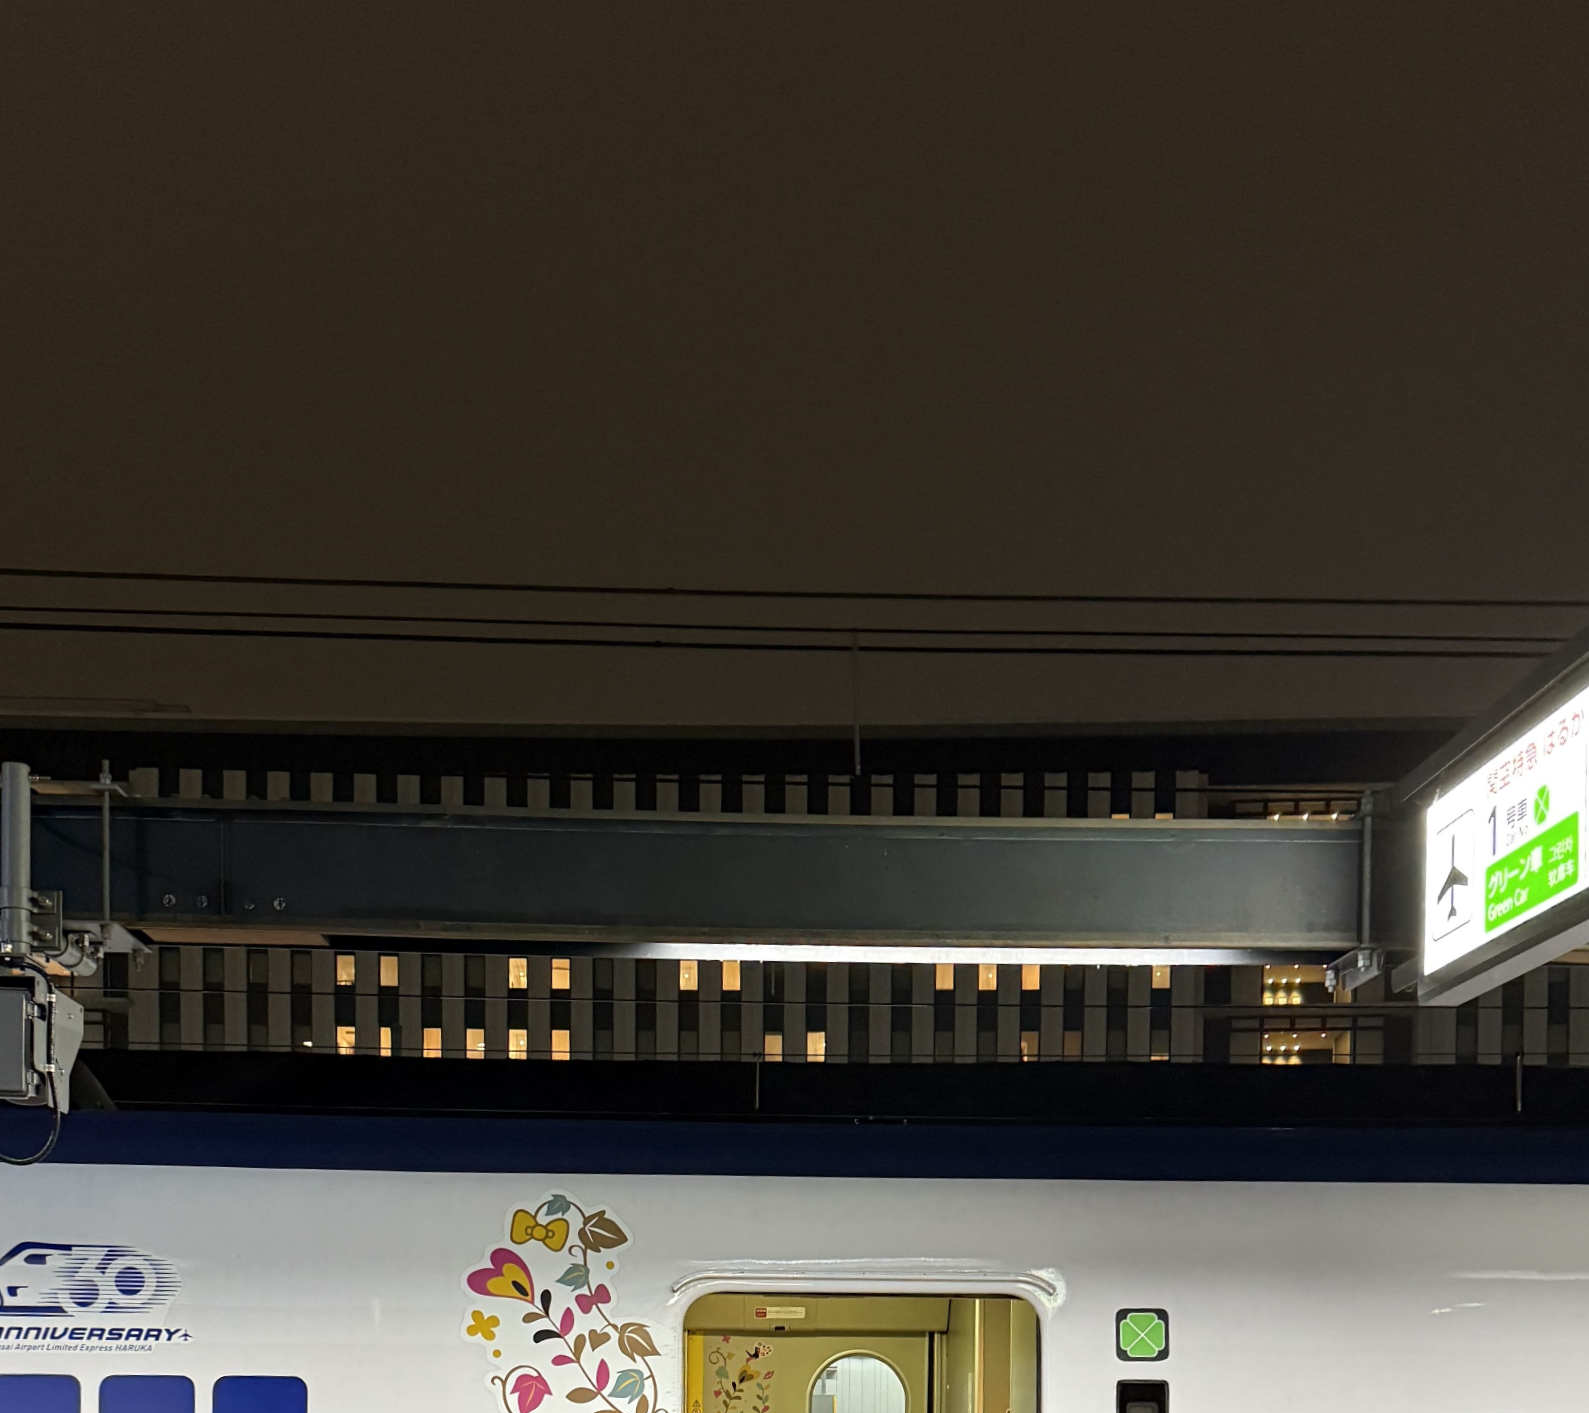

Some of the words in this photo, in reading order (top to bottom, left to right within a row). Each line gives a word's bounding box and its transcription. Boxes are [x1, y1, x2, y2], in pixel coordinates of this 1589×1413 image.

[1488, 805, 1497, 856] 1
[1488, 845, 1543, 900] グリーン車
[1488, 897, 1513, 922] Green
[1514, 887, 1530, 907] Car
[0, 1326, 182, 1341] NNIVERSARY
[14, 1343, 45, 1352] Airport
[46, 1343, 79, 1351] Limited
[79, 1344, 114, 1353] Express
[115, 1344, 153, 1352] HARUKA
